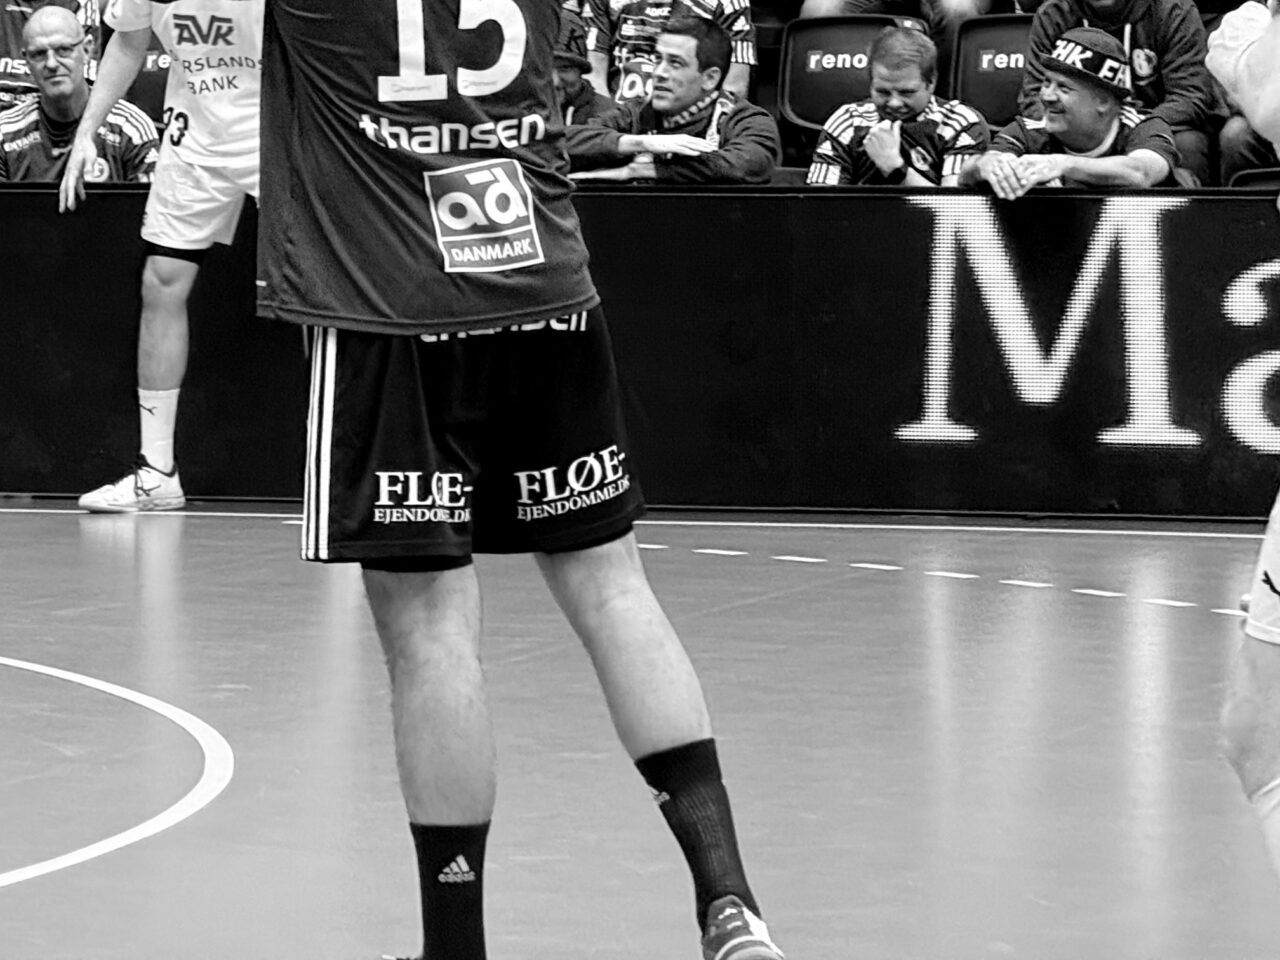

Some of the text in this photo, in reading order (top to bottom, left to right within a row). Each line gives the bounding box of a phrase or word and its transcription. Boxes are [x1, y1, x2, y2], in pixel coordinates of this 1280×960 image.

[172, 13, 236, 46] AVK
[358, 113, 546, 154] thansen
[436, 166, 529, 231] ad
[450, 238, 534, 263] DANMARK
[513, 444, 626, 504] FLØE-
